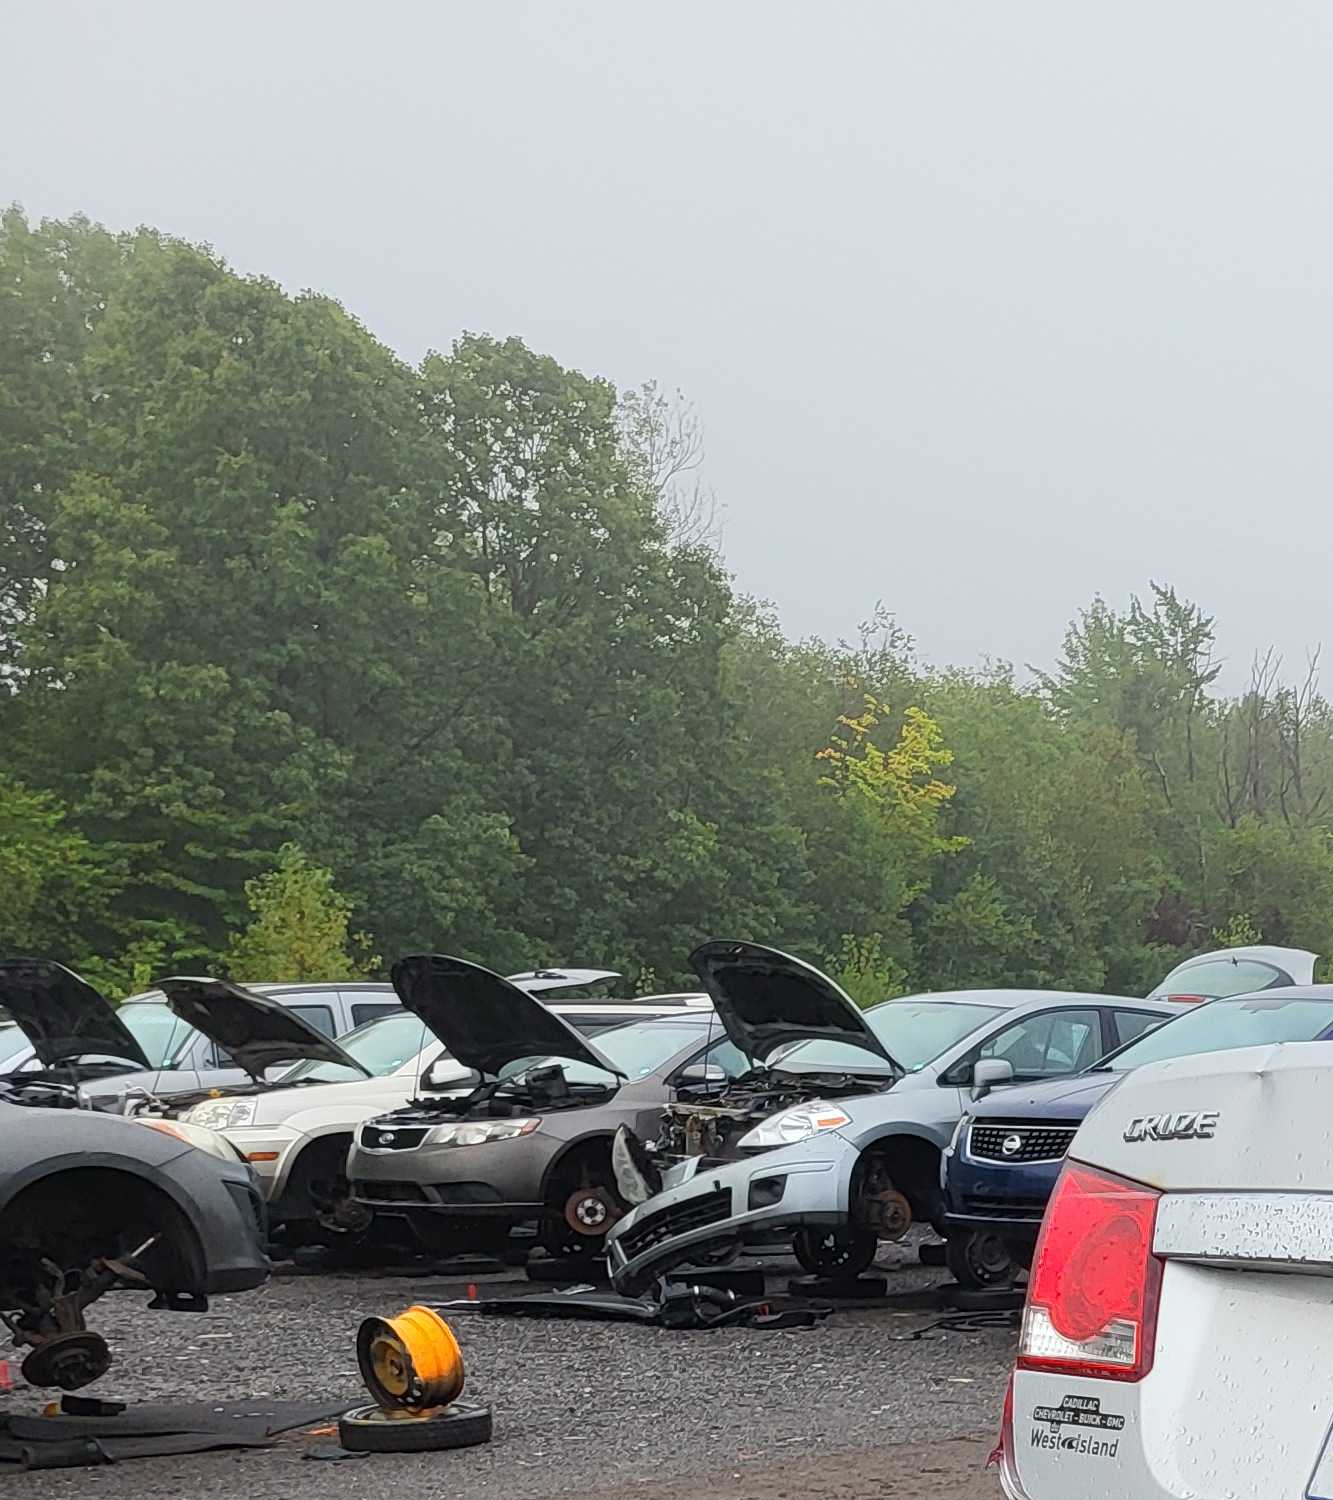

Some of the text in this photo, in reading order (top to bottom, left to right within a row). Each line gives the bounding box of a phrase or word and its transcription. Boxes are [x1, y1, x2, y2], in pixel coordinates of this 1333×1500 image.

[1123, 1112, 1220, 1142] CRUZE
[1063, 1397, 1099, 1411] CADILLAC
[1034, 1408, 1124, 1429] CHEVROLET BUICK GMC
[1030, 1427, 1120, 1458] West island
